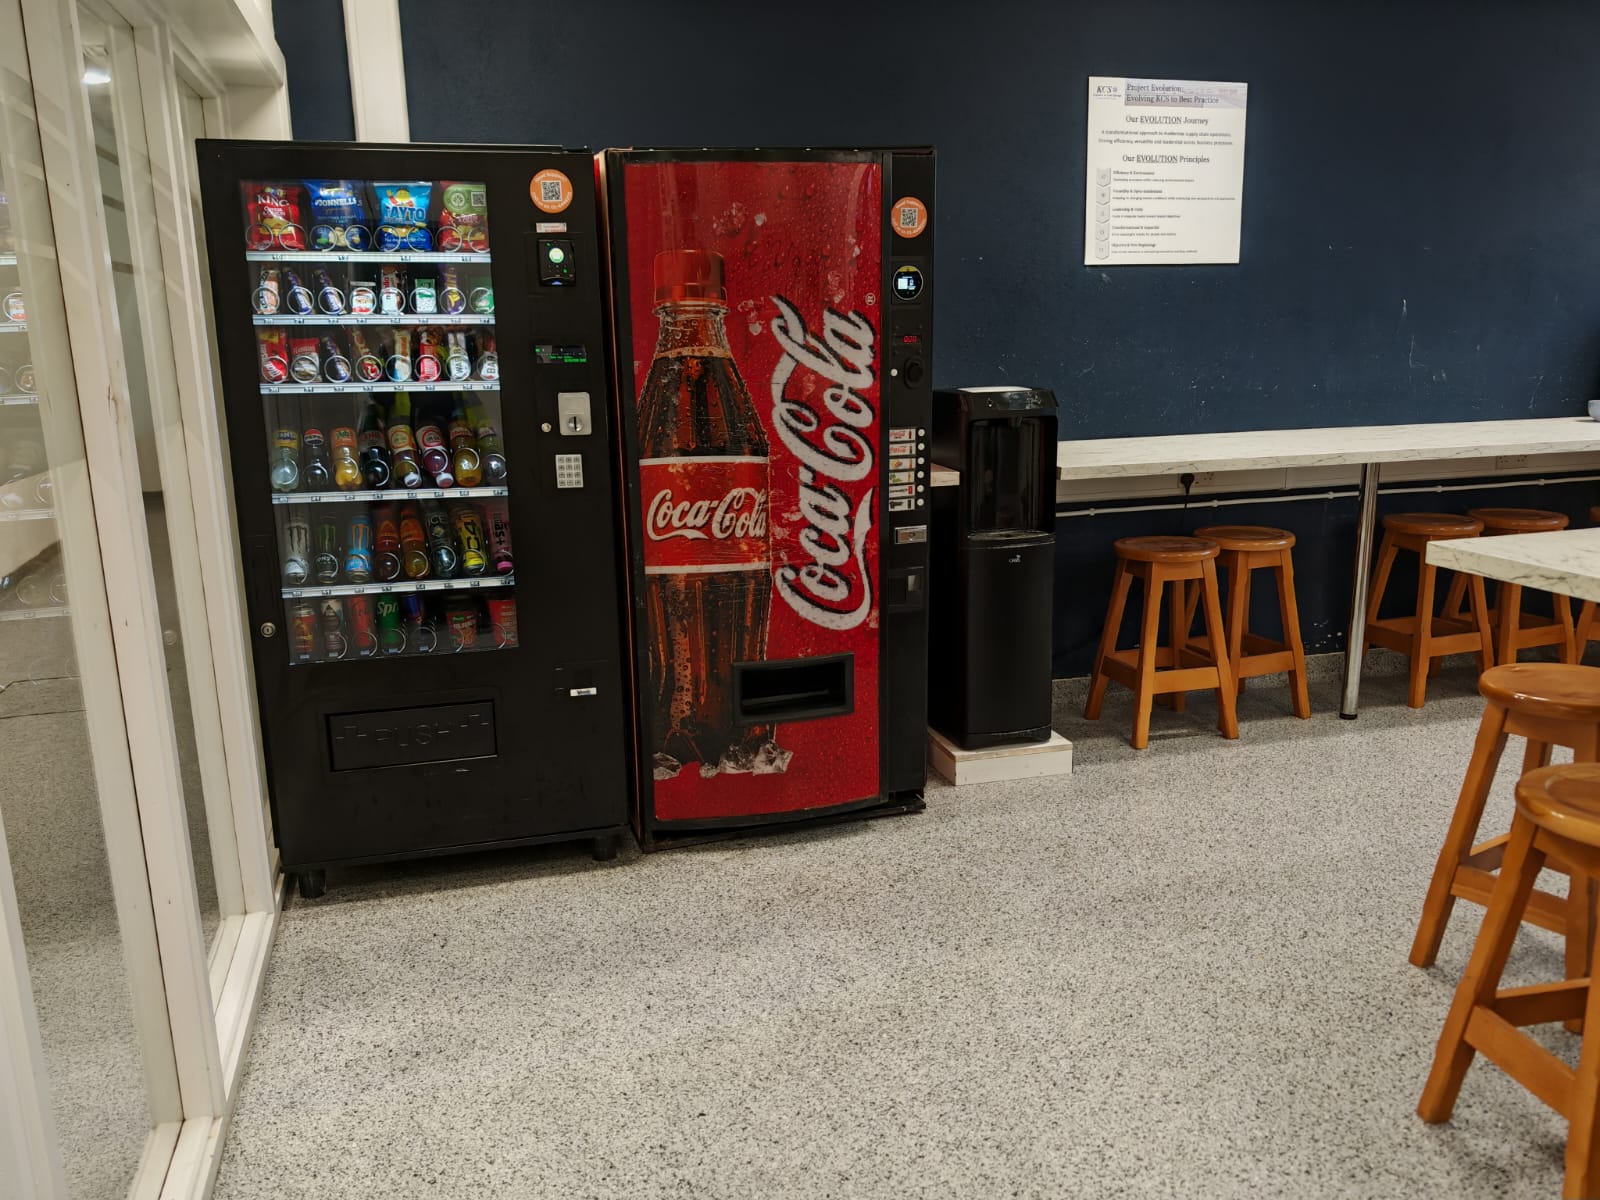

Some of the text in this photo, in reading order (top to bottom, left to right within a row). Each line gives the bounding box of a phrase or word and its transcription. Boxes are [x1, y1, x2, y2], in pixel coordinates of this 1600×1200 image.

[1126, 84, 1184, 93] Project Evolution:
[1126, 94, 1155, 103] Evolving
[1155, 95, 1170, 103] KCS
[1170, 95, 1178, 103] to
[1178, 95, 1193, 103] Best
[1193, 96, 1220, 104] Practice
[1125, 115, 1209, 125] Our EVOLUTION Journey
[1122, 154, 1210, 164] Our EVOLUTION Principles
[257, 194, 290, 207] KING
[770, 295, 876, 631] Coca-Cola
[646, 487, 768, 541] Coca-Cola
[377, 601, 400, 617] Spr
